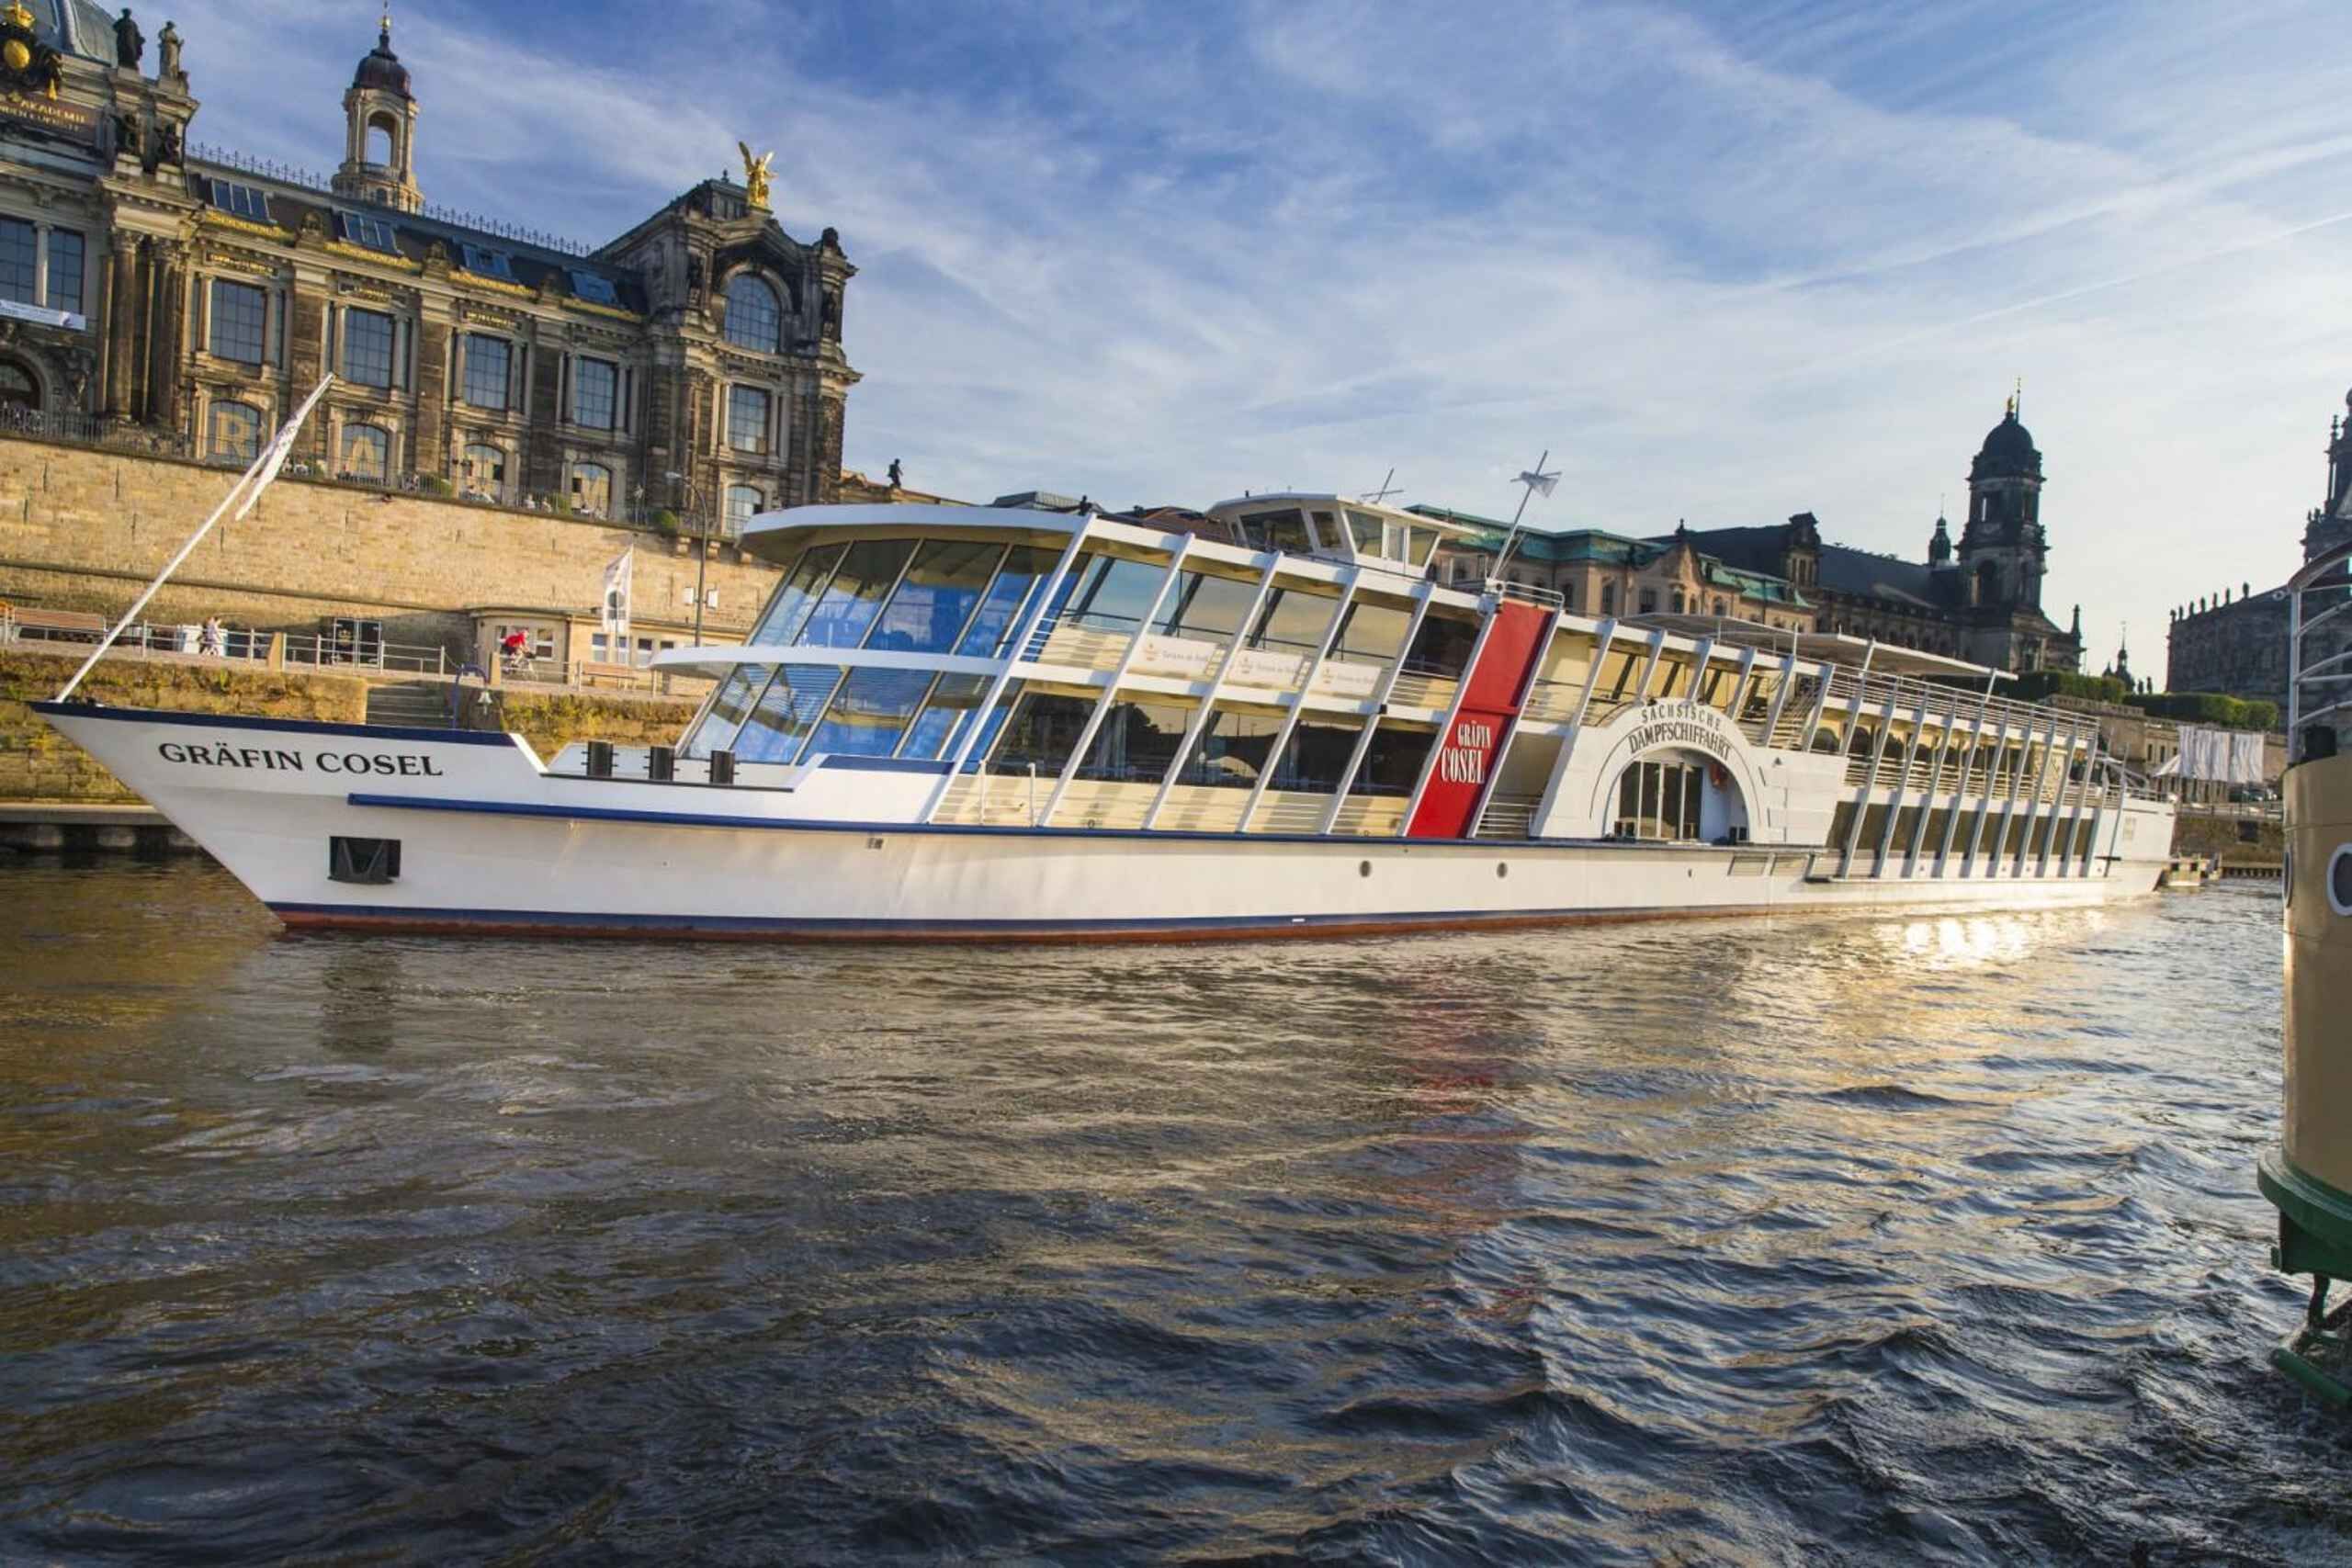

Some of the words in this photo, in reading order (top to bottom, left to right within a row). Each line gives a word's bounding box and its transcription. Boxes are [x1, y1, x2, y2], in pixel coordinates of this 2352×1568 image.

[1457, 720, 1491, 750] GRÄFIN
[1628, 722, 1731, 761] DAMPFSCHIFFAHRT
[158, 742, 304, 772] GRÄFIN
[315, 752, 444, 776] COSEL
[1441, 747, 1485, 784] COSEL
